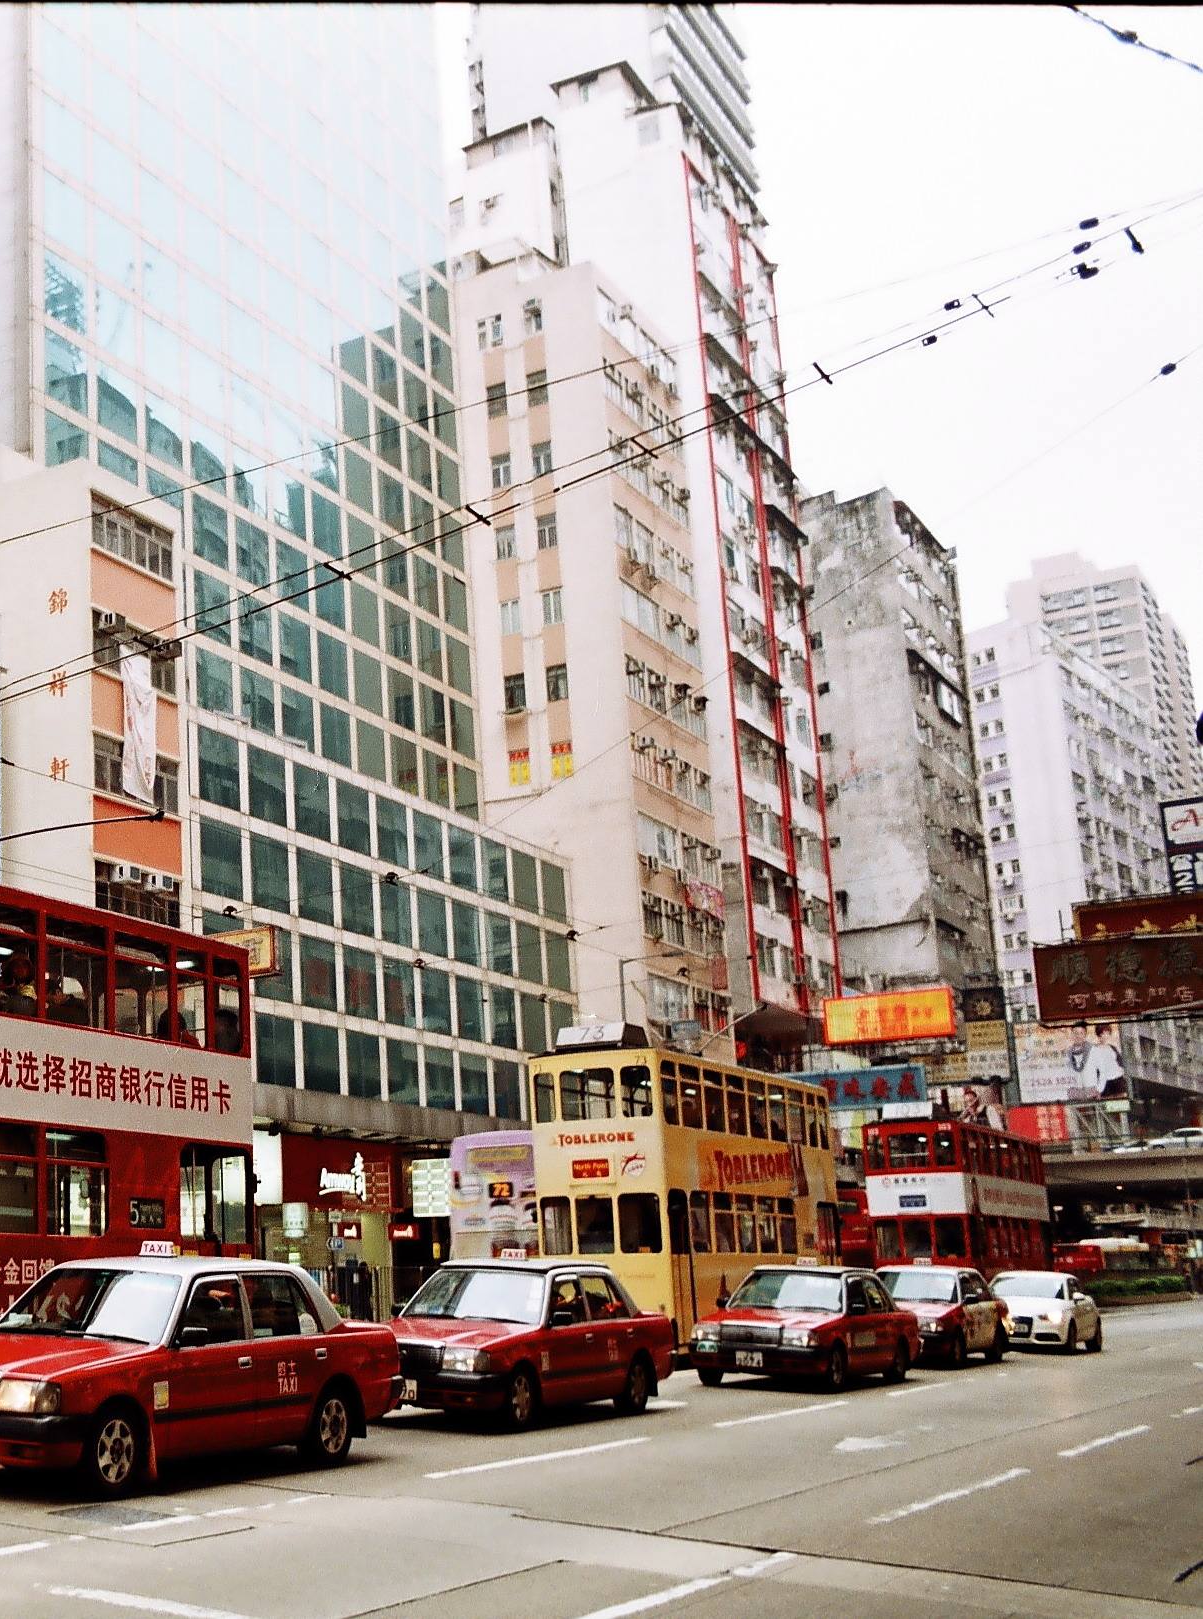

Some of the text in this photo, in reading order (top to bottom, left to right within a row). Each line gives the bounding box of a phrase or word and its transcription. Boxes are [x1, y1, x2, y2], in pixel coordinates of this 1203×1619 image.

[558, 1131, 635, 1147] TOBLERONE
[143, 1243, 167, 1254] TAXI
[503, 1250, 526, 1259] TAXI
[277, 1376, 298, 1394] TAXI
